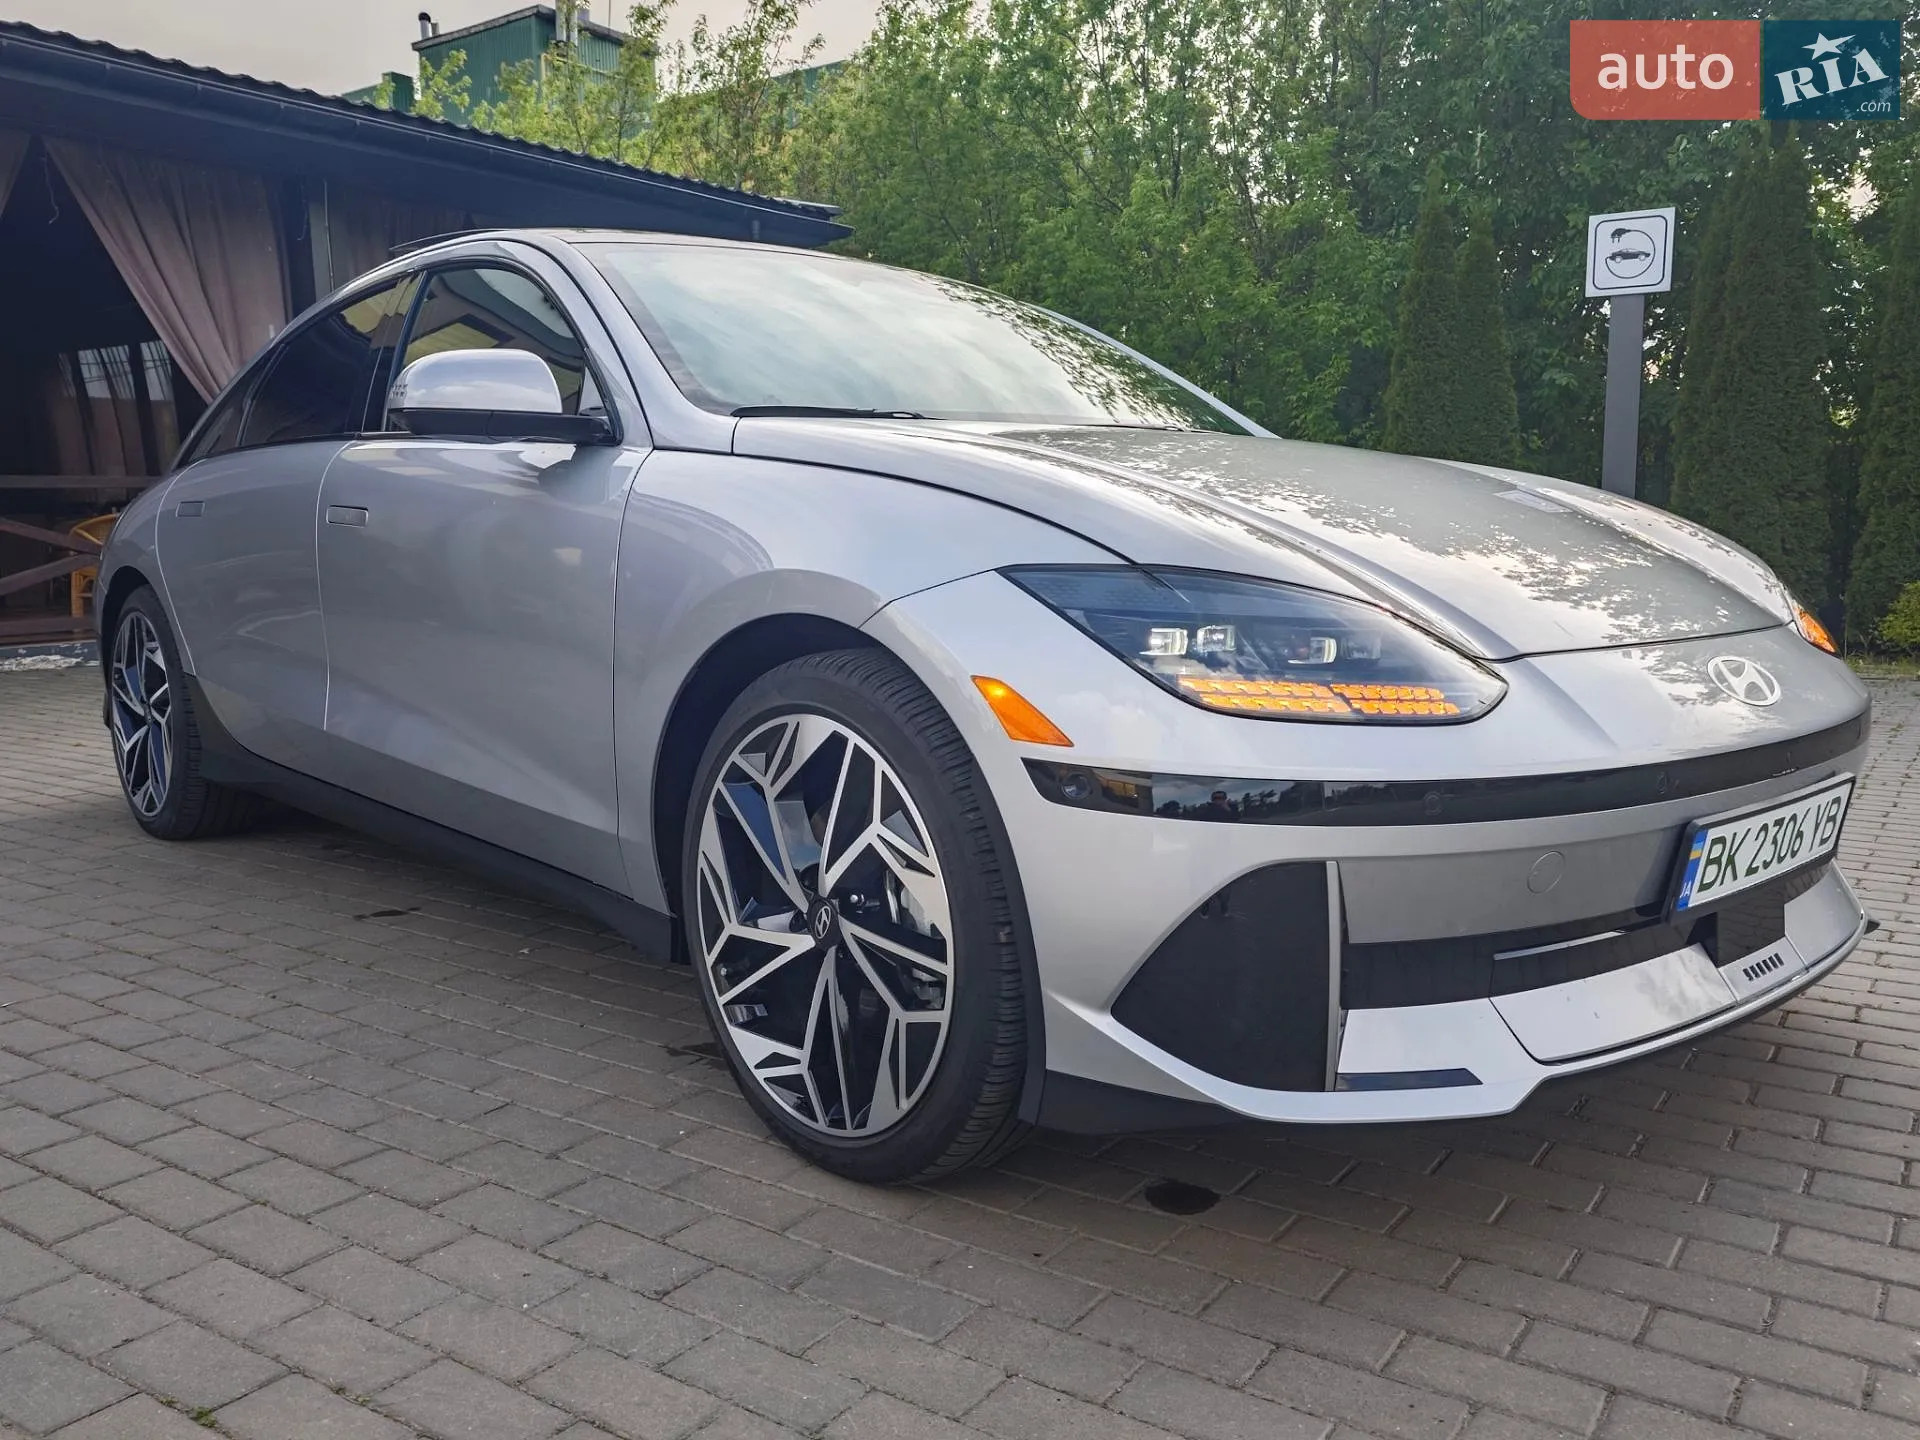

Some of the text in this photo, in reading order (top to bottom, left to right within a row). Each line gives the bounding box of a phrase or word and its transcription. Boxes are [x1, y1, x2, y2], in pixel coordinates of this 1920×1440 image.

[1697, 796, 1842, 893] BK 2306 YB
